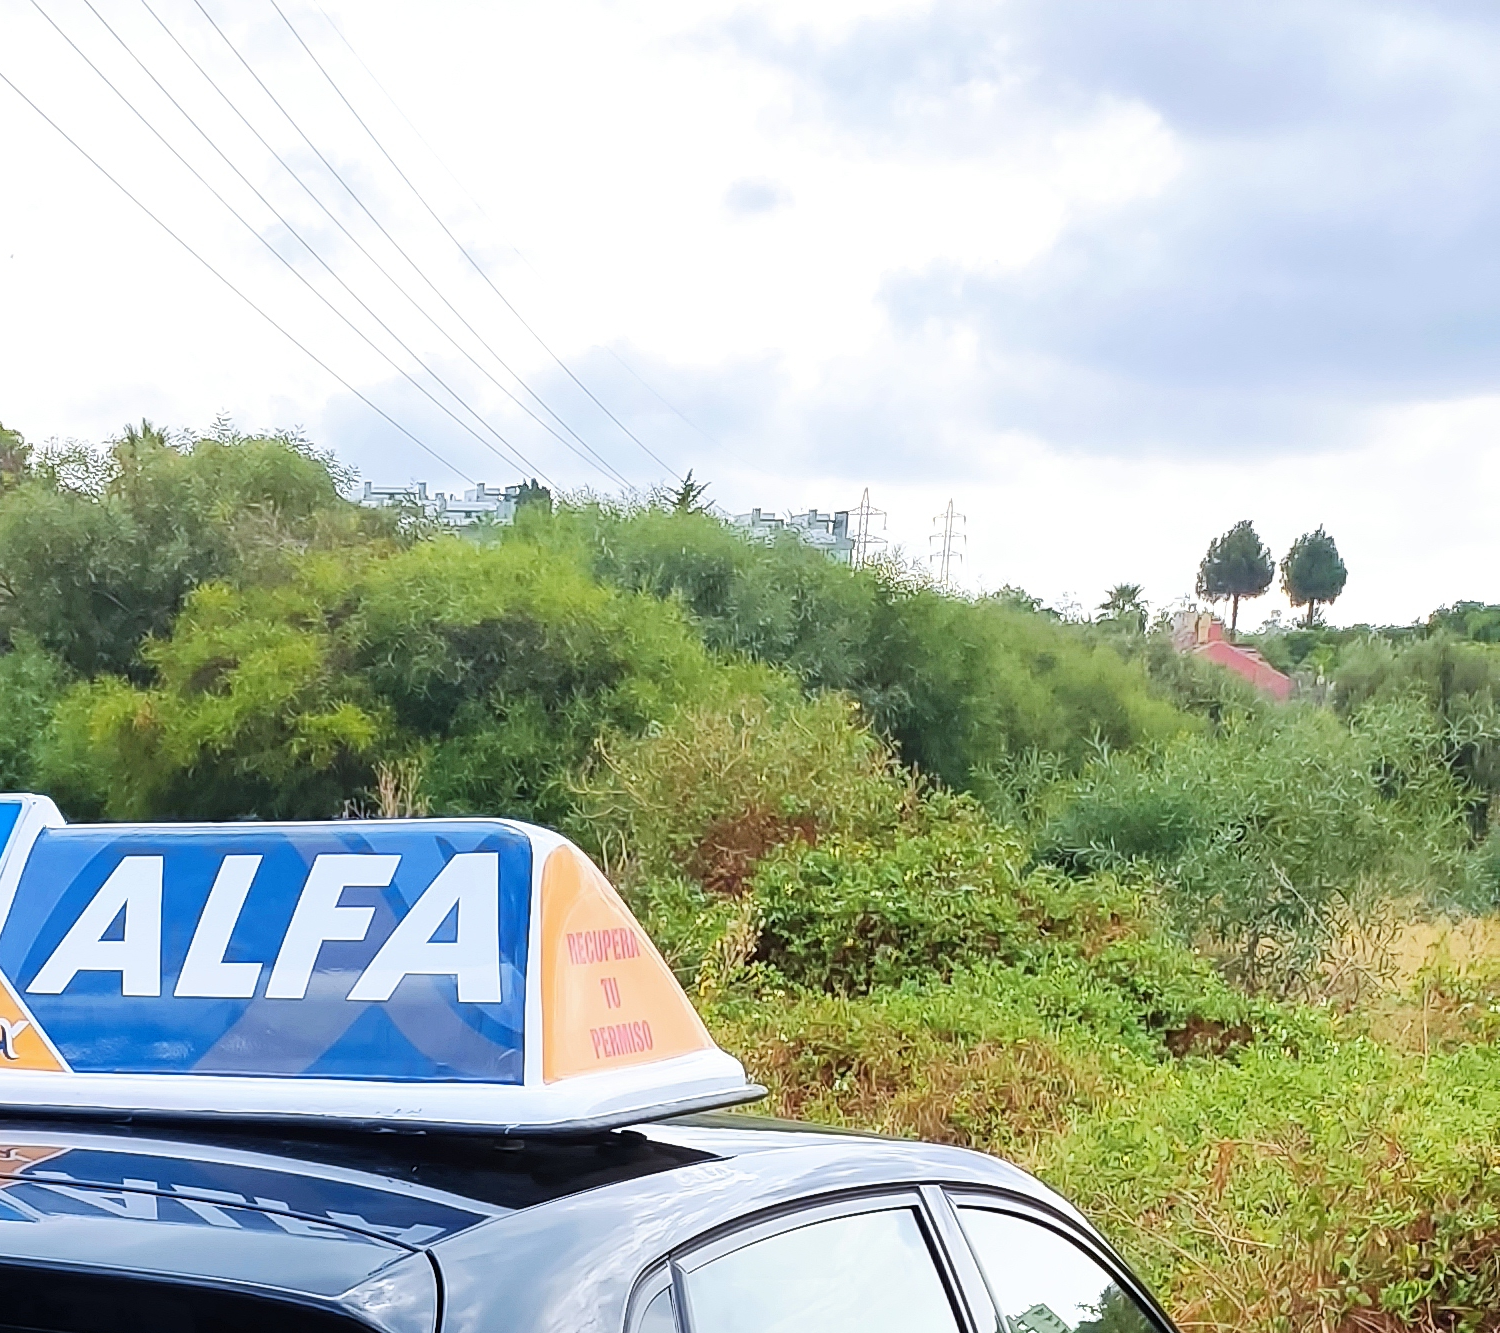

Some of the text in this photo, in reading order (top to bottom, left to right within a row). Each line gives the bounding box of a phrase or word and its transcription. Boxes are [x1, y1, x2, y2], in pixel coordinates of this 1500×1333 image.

[26, 853, 502, 1003] ALFA
[567, 928, 640, 965] RECUPERA
[601, 978, 621, 1010] TU
[590, 1020, 653, 1059] PERMISO
